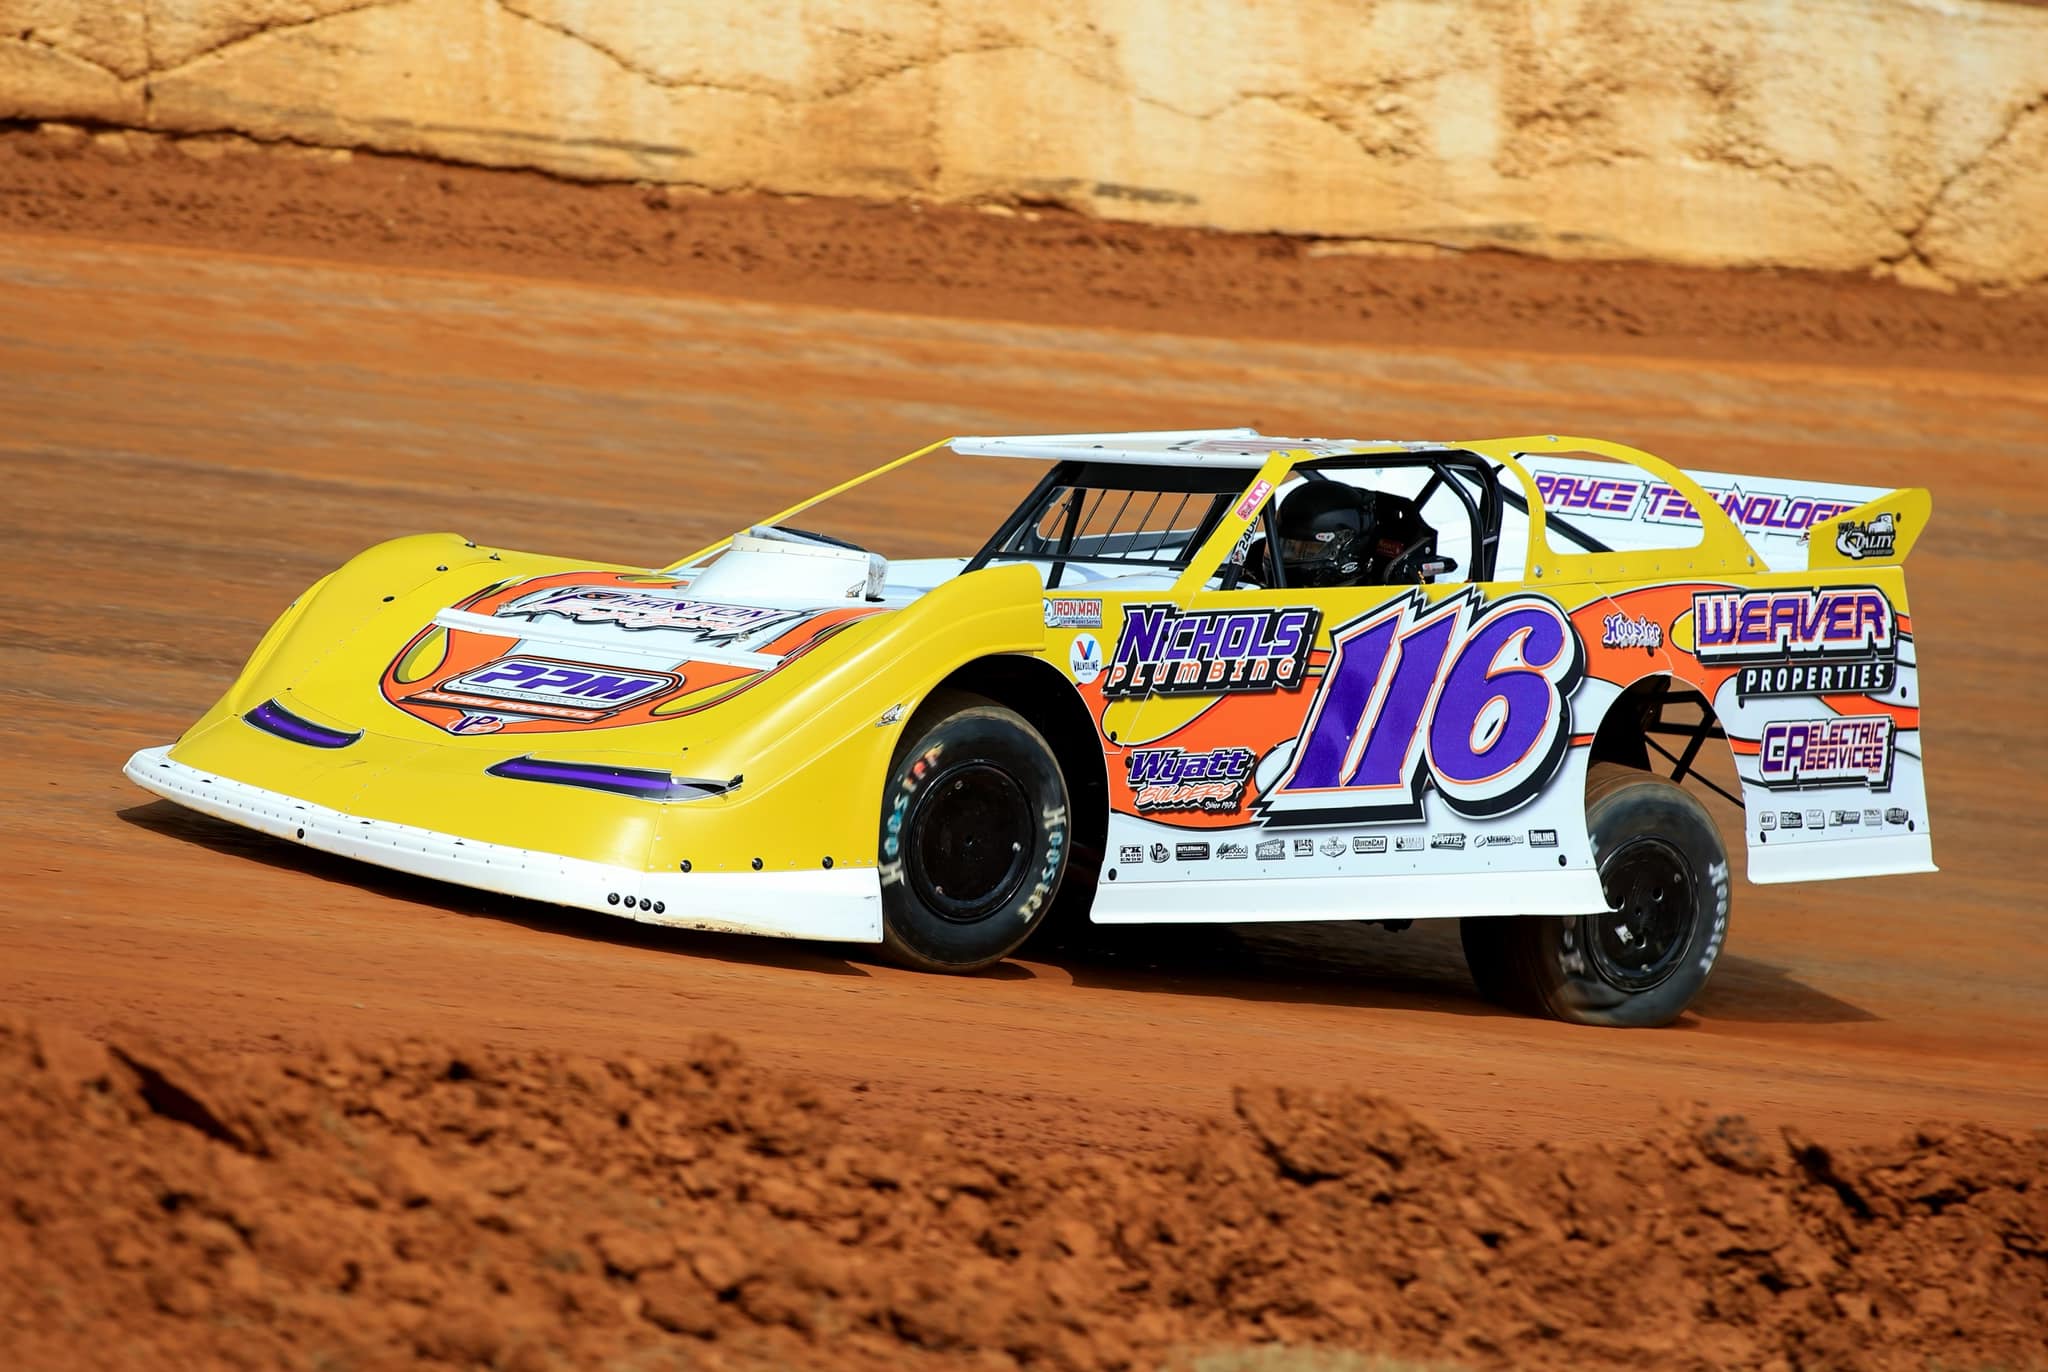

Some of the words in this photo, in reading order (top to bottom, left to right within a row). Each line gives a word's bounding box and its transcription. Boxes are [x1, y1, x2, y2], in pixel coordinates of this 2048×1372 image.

[1535, 475, 1639, 512] RAYCE
[1648, 486, 1856, 530] TECNOLOGI
[1054, 601, 1077, 616] IRON
[1078, 601, 1100, 616] MAN
[1697, 592, 1888, 647] WEAVER
[1116, 609, 1307, 664] NICHOLS
[470, 662, 660, 701] PPM
[1744, 663, 1886, 694] PROPERTIES
[1272, 602, 1568, 797] 116
[452, 715, 499, 733] VP
[1808, 722, 1887, 747] ELECTRIC
[1130, 750, 1249, 786] Wyatt
[1805, 746, 1884, 771] SERVICES
[1136, 782, 1238, 804] BUILDERS
